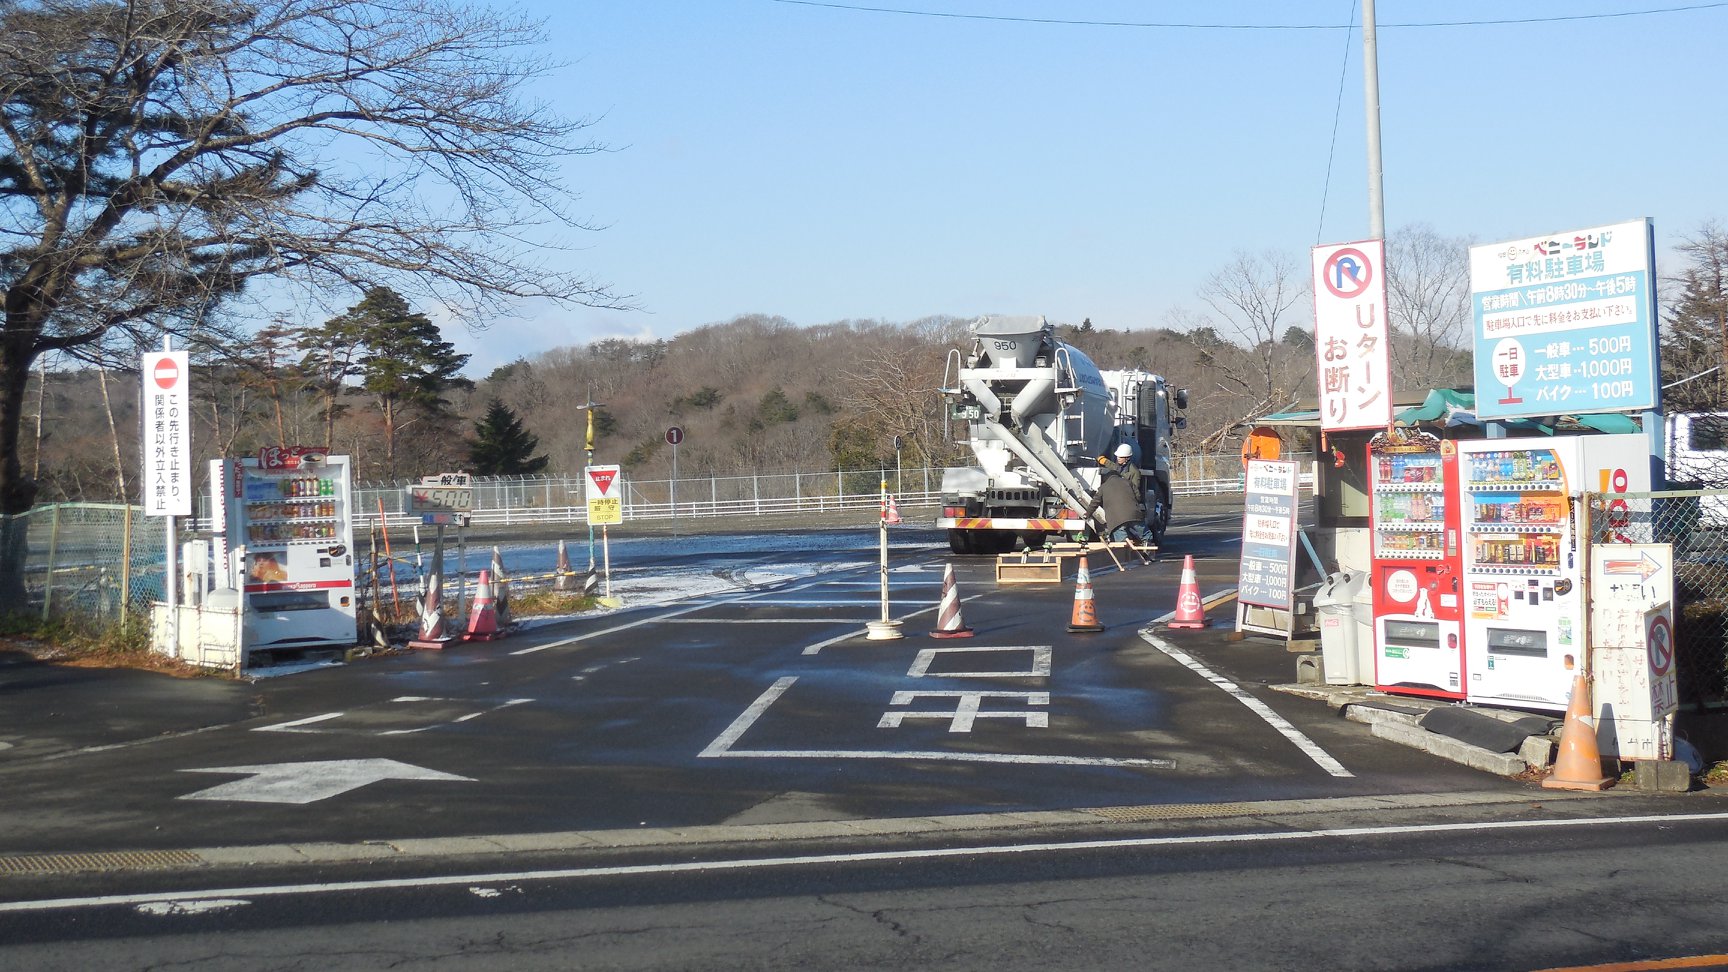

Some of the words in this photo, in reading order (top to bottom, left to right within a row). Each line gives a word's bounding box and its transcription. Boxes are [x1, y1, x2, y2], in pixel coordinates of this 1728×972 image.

[1533, 230, 1613, 256] ベニーランド
[1506, 250, 1605, 285] 有料駐車場
[994, 340, 1017, 350] 950
[1498, 347, 1518, 361] 一日
[1355, 303, 1382, 410] Uターン
[1324, 336, 1350, 424] お断り
[1499, 363, 1520, 378] 駐車
[670, 429, 677, 443] 1
[154, 393, 167, 511] 関係者以外立入禁止
[427, 474, 467, 486] 一般車
[1254, 476, 1287, 491] 有料駐車場
[1651, 674, 1677, 715] 禁止
